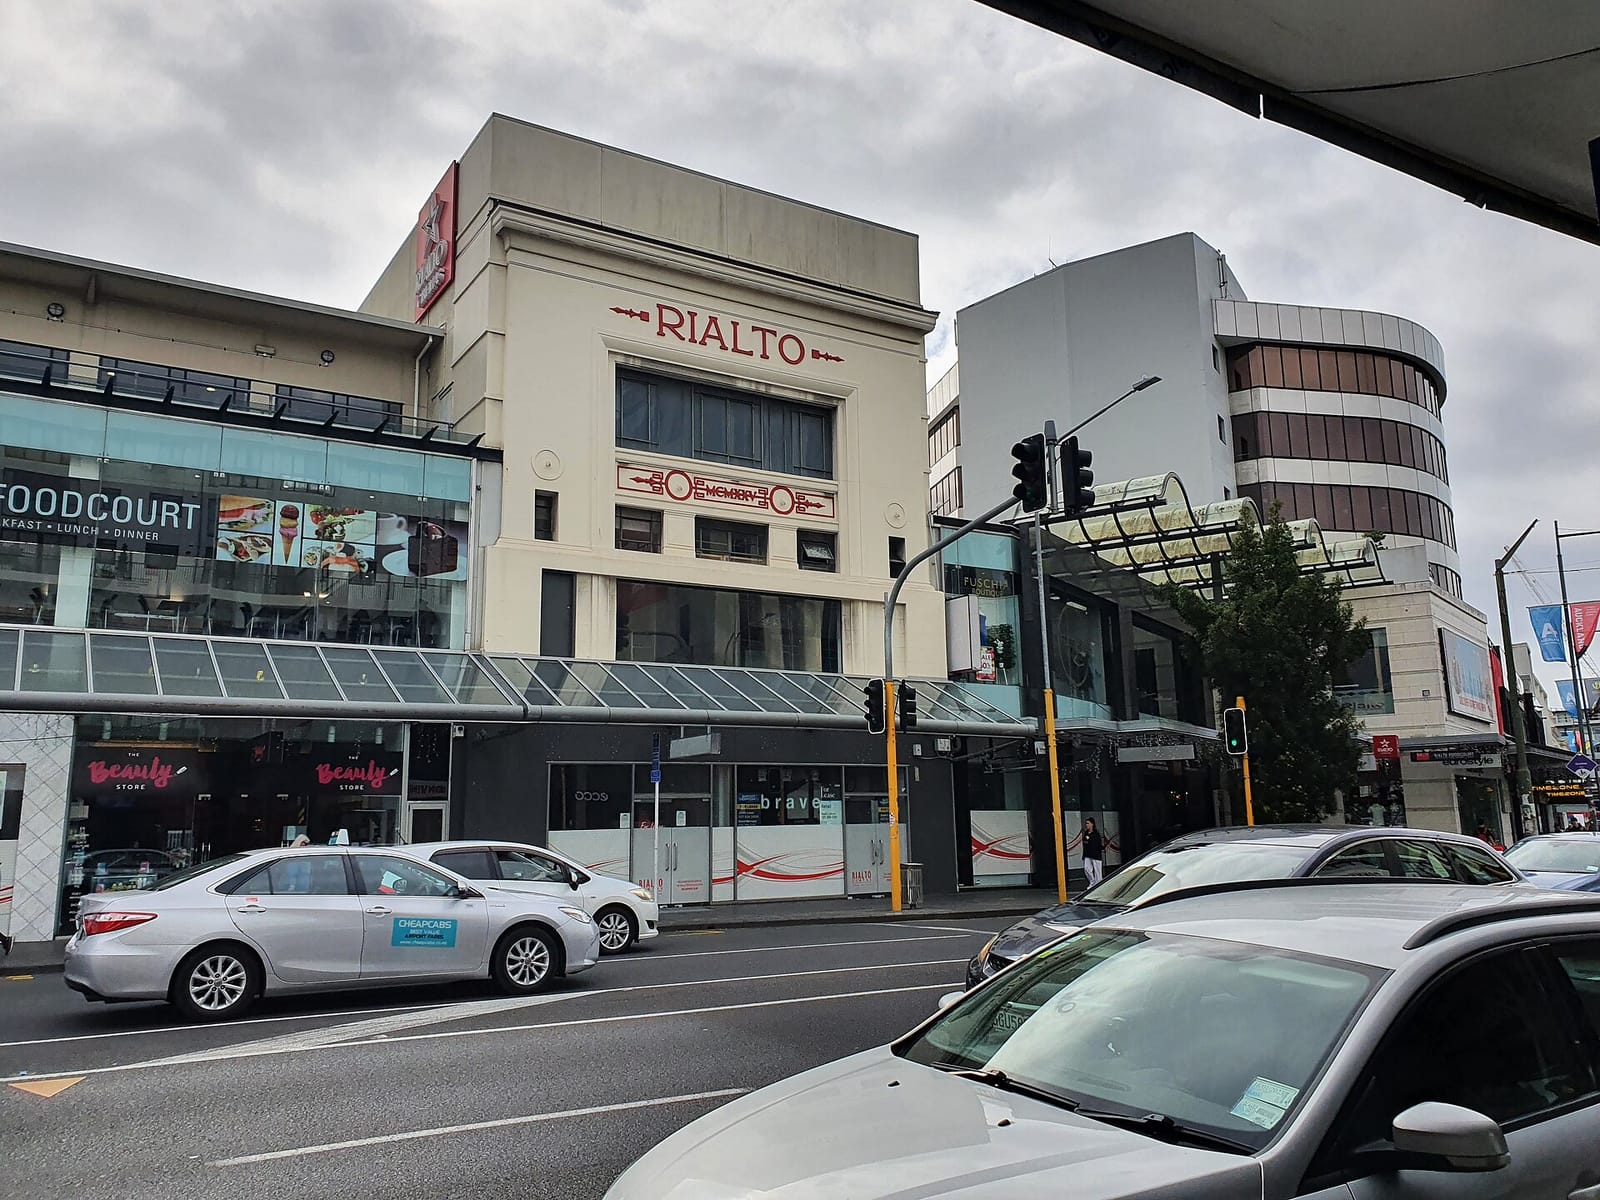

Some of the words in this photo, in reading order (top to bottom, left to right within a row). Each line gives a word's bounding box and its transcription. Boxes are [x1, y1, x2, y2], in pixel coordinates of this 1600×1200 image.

[656, 303, 806, 365] RIALTO
[57, 523, 99, 535] LUNCH
[114, 528, 159, 541] DINNER
[760, 793, 821, 809] brave
[638, 878, 664, 889] RIALO
[398, 920, 452, 929] CHEAPCABS
